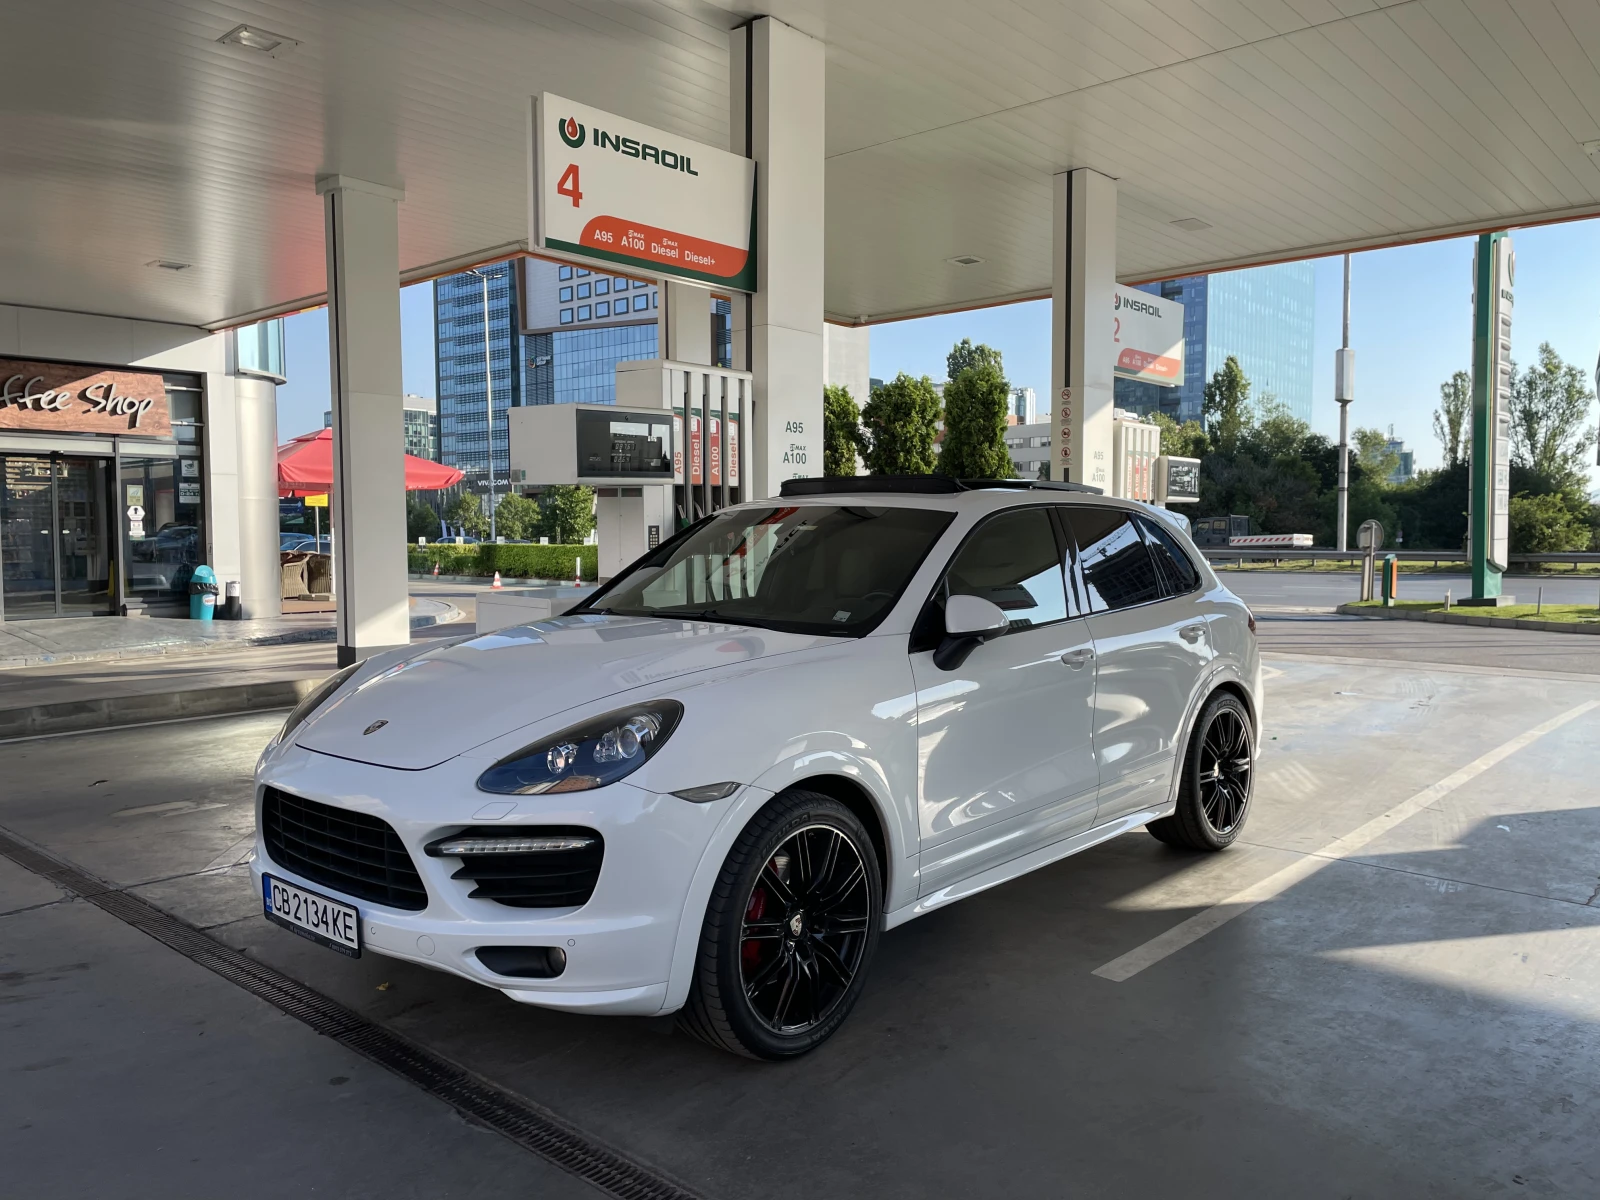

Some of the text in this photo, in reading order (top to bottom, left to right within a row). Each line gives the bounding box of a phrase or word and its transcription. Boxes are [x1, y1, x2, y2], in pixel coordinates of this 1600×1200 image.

[593, 128, 698, 177] INSAOIL
[557, 163, 583, 208] 4
[594, 229, 715, 265] A95 A100 Diesel Diesel+
[1124, 297, 1162, 318] INSAOIL
[1114, 317, 1120, 342] 2
[85, 382, 154, 427] Shop
[785, 421, 804, 434] A95
[692, 439, 700, 475] Diesel
[711, 446, 719, 476] A100
[729, 436, 737, 477] Diesel+
[782, 451, 807, 464] A100
[1094, 450, 1104, 460] A95
[1092, 473, 1106, 483] A100
